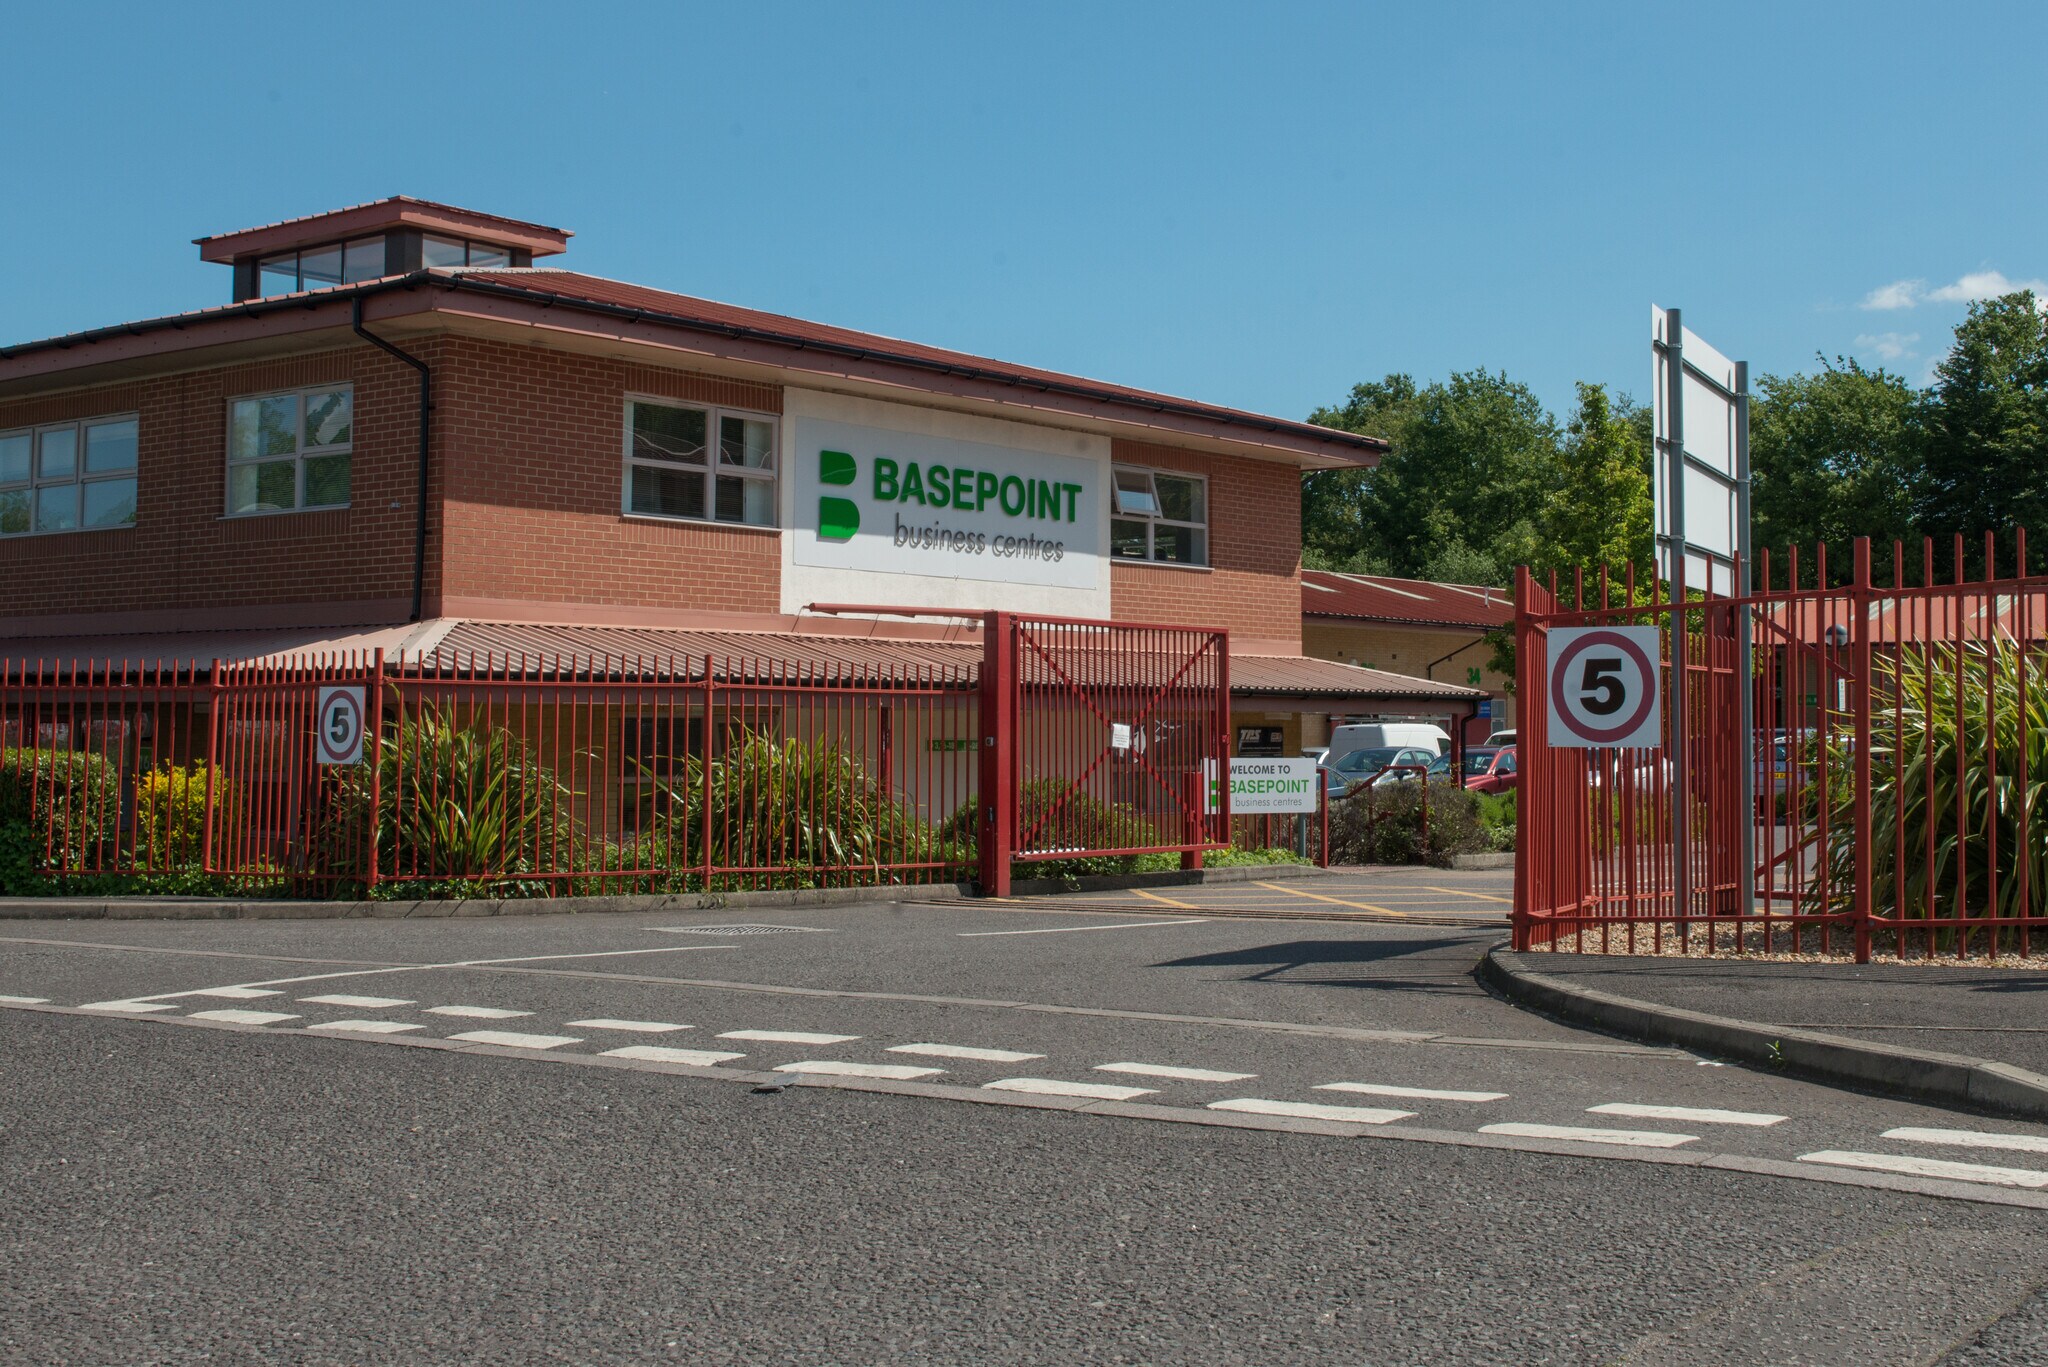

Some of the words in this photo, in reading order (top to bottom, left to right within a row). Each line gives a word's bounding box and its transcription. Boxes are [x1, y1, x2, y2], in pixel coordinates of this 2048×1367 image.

[873, 457, 1083, 523] BASEPOINT
[894, 512, 986, 552] business
[993, 532, 1064, 560] centres
[1580, 658, 1626, 715] 5
[330, 706, 350, 744] 5
[1230, 765, 1275, 775] WELCOME
[1279, 764, 1291, 775] TO
[1230, 779, 1310, 794] BASEPOINT
[1235, 796, 1271, 807] business
[1273, 797, 1303, 807] centres
